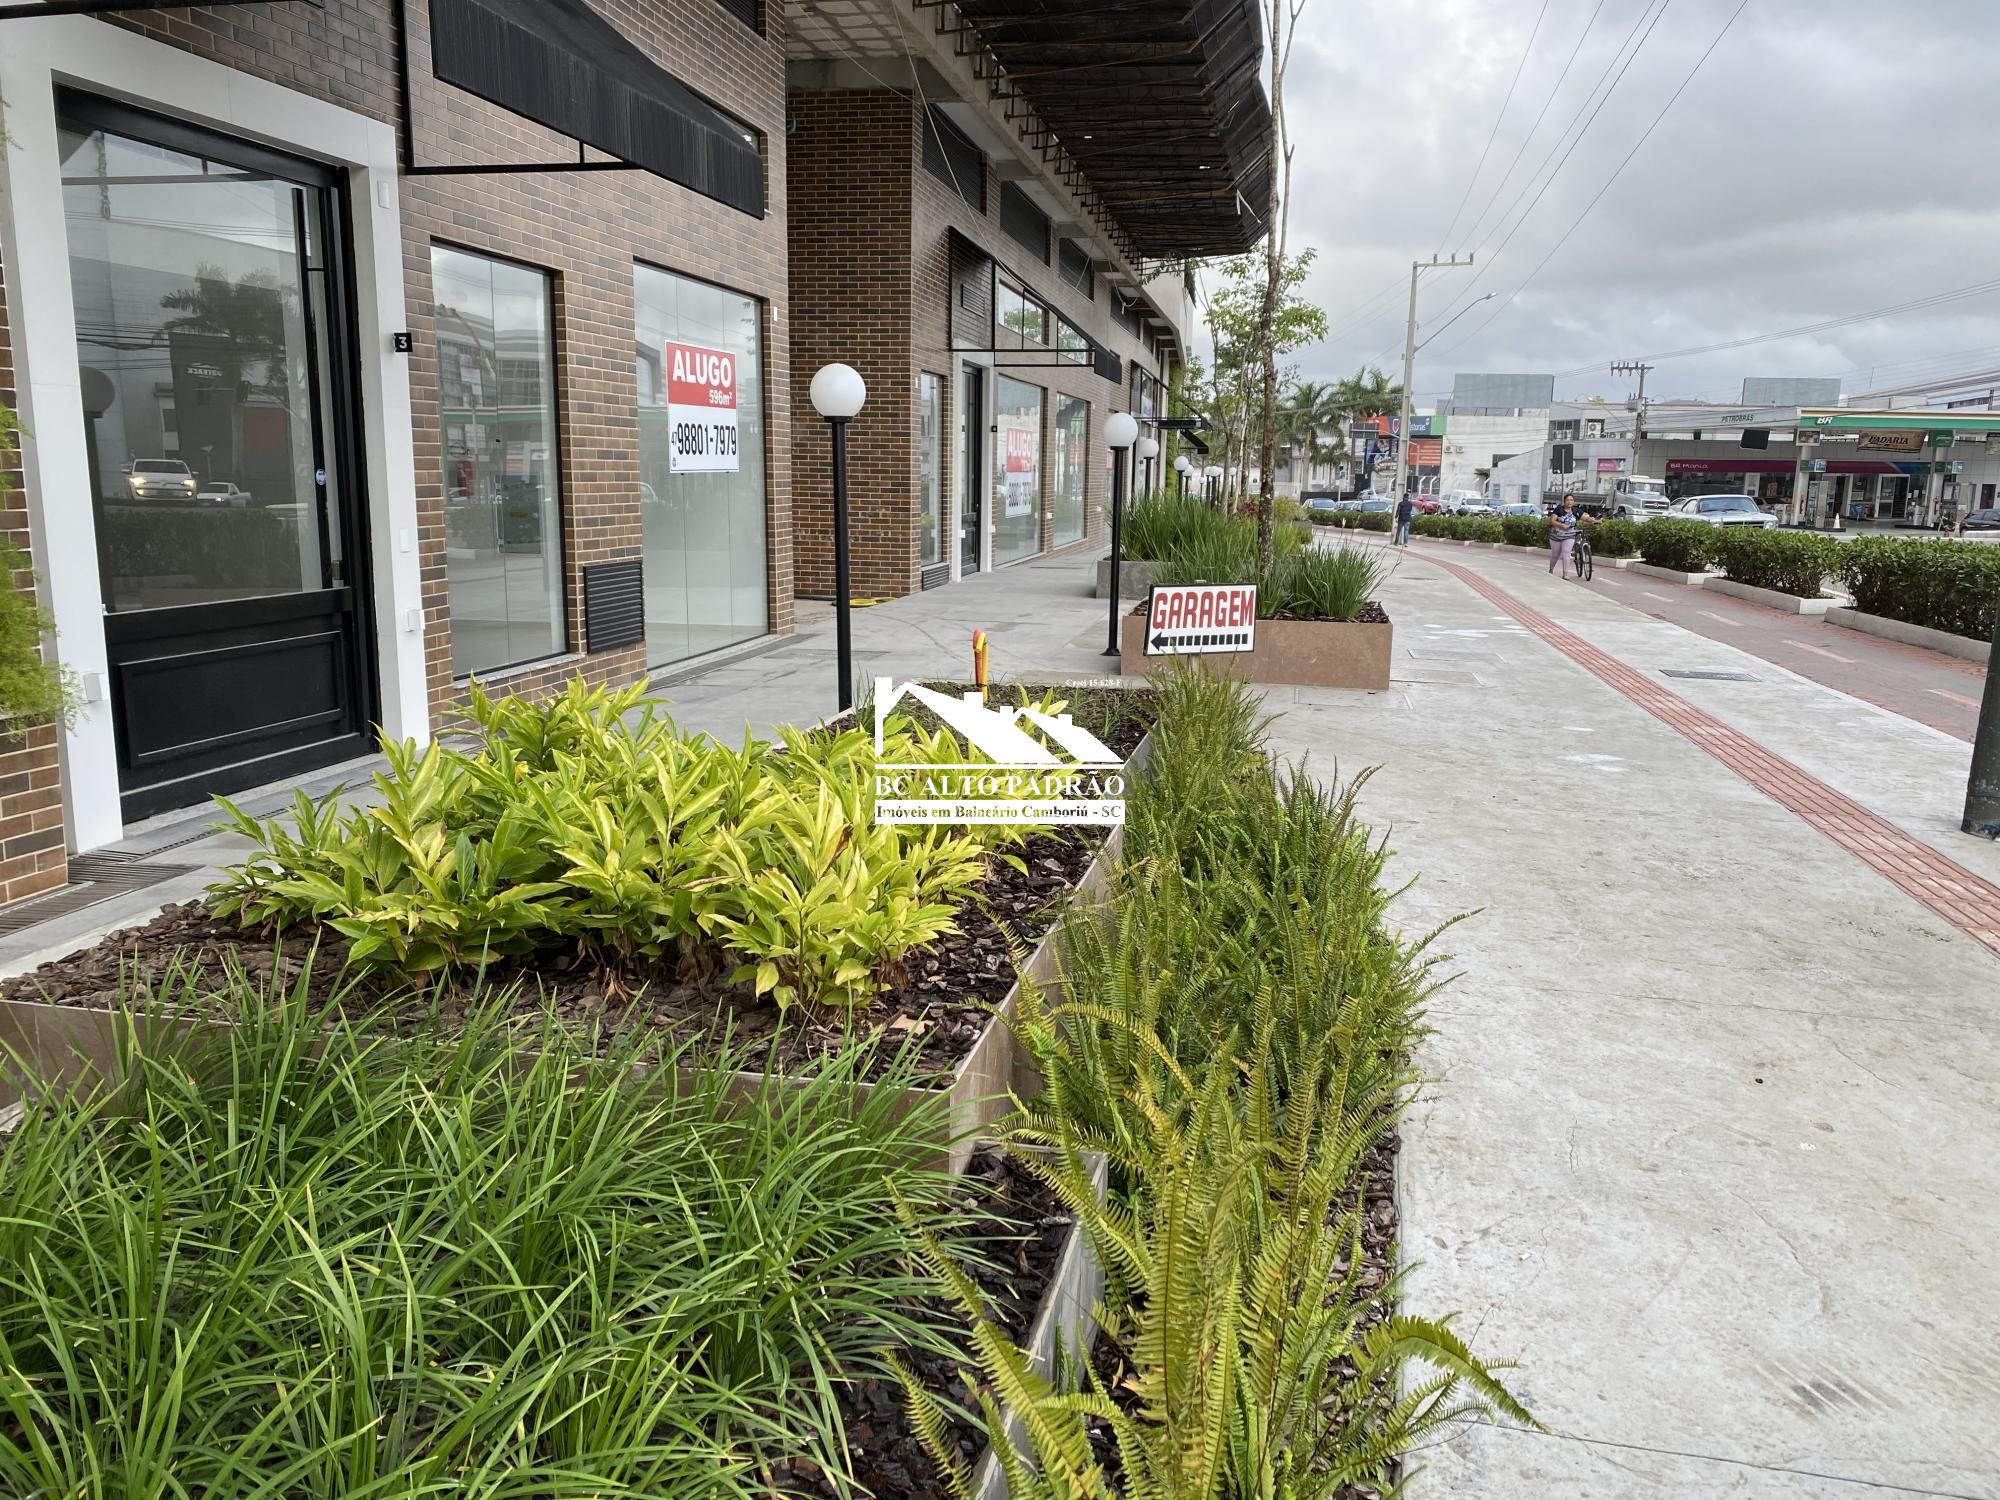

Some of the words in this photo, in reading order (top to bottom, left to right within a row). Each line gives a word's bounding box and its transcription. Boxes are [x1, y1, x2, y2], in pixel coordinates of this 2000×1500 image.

[398, 336, 408, 349] 3
[672, 349, 732, 388] ALUGO
[709, 389, 733, 406] 596m²
[1721, 414, 1754, 423] PETROBRAS
[1816, 416, 1833, 425] BR
[677, 422, 737, 456] 98801-7979
[1868, 436, 1909, 445] PADARIA
[1152, 590, 1255, 630] GARAGEM
